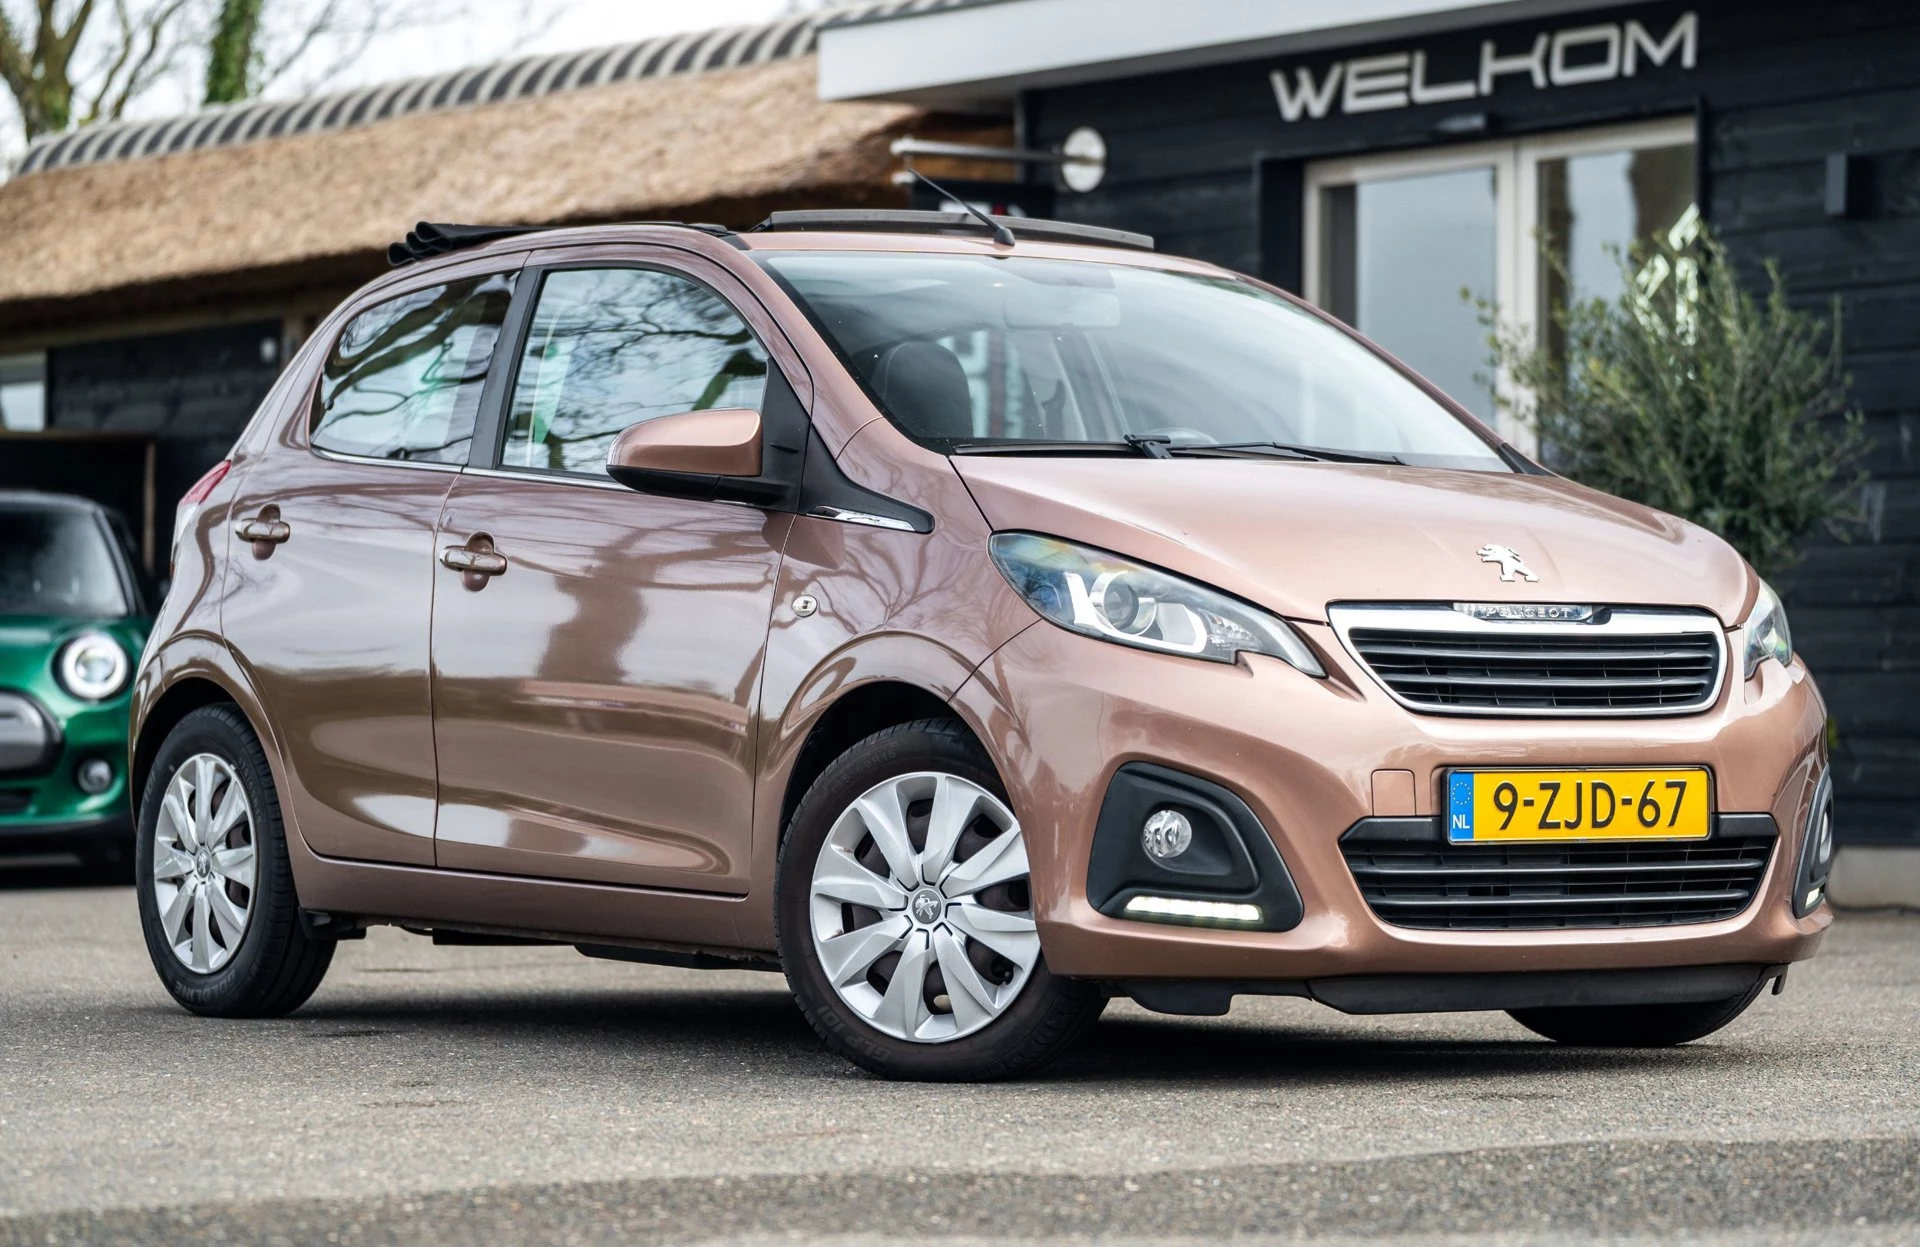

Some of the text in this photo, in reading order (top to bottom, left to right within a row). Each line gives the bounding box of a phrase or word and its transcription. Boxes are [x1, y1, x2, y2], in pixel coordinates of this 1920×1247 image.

[1270, 12, 1698, 121] WELKOM
[1485, 606, 1571, 619] PEUGEOT
[1452, 814, 1470, 829] NL
[1493, 780, 1688, 831] 9-ZJD-67
